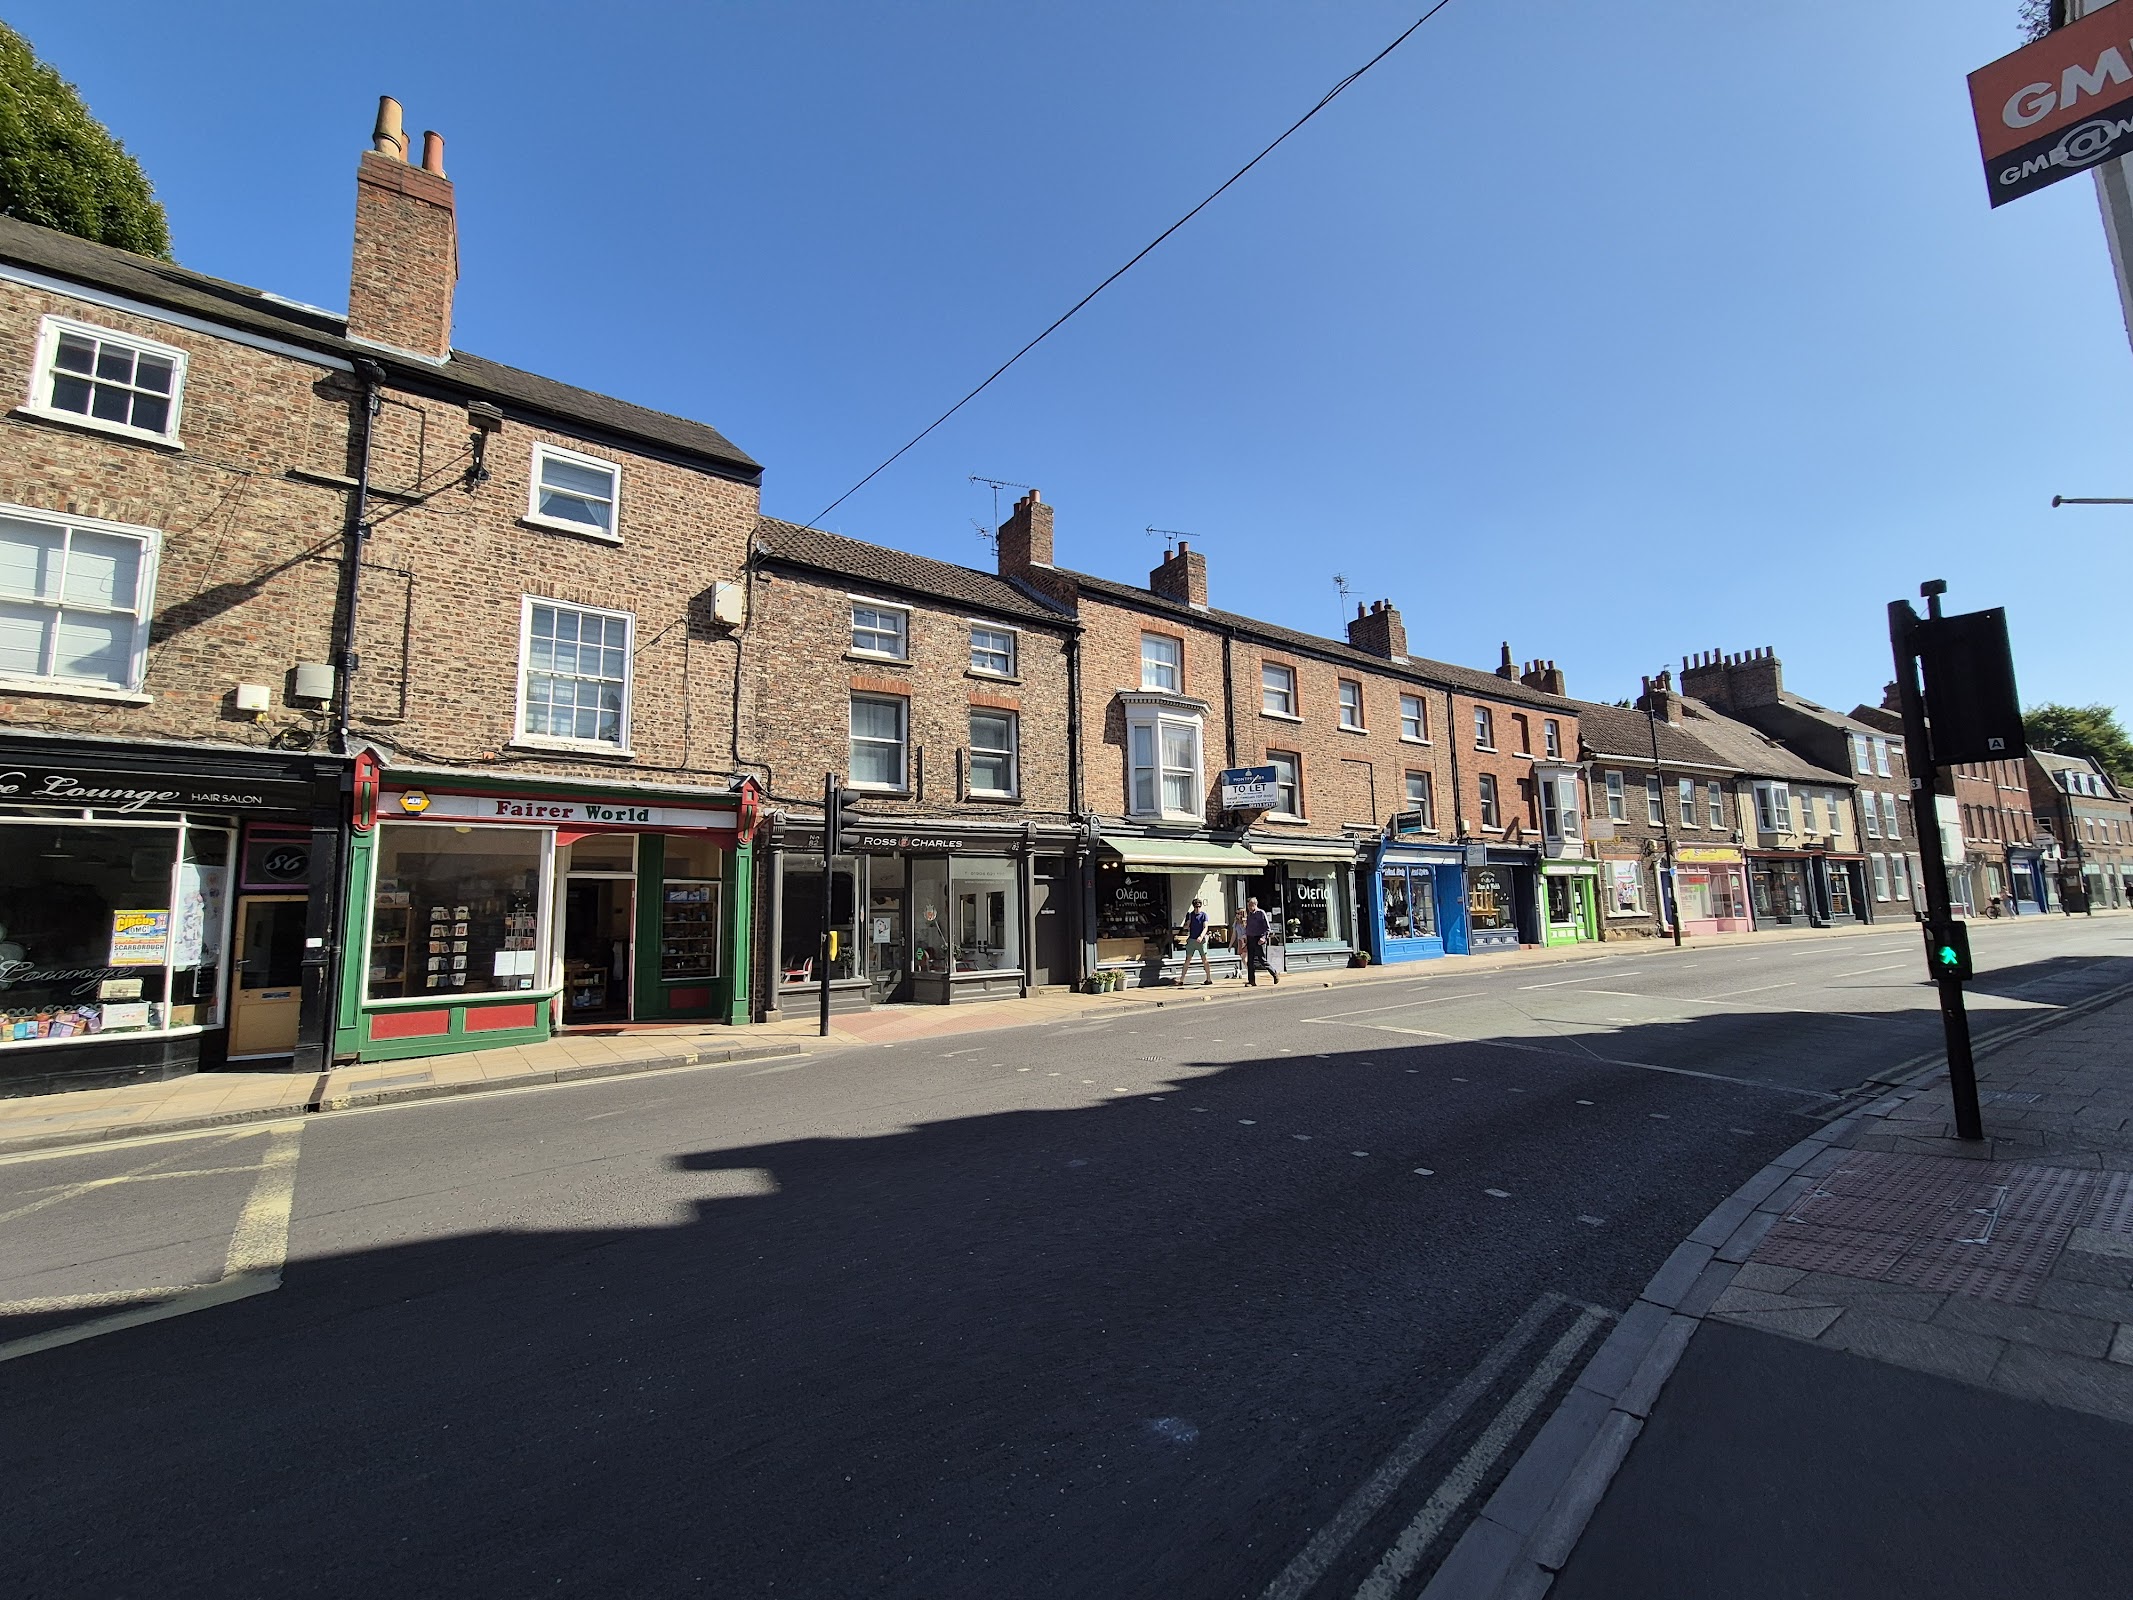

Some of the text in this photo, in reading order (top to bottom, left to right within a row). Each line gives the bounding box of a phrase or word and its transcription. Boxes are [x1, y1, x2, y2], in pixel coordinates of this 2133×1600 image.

[2002, 38, 2133, 129] GM
[1992, 739, 2002, 749] A
[31, 775, 180, 813] Lounge
[192, 792, 220, 803] HAIR
[222, 794, 262, 804] SALON
[1233, 783, 1267, 793] TO LET
[495, 800, 650, 822] Fairer World
[864, 836, 963, 848] ROSS CHARLES
[265, 854, 308, 871] 86
[115, 917, 156, 932] CIRCUS
[114, 943, 166, 951] SCARBOROUGH
[0, 959, 137, 996] Lounge
